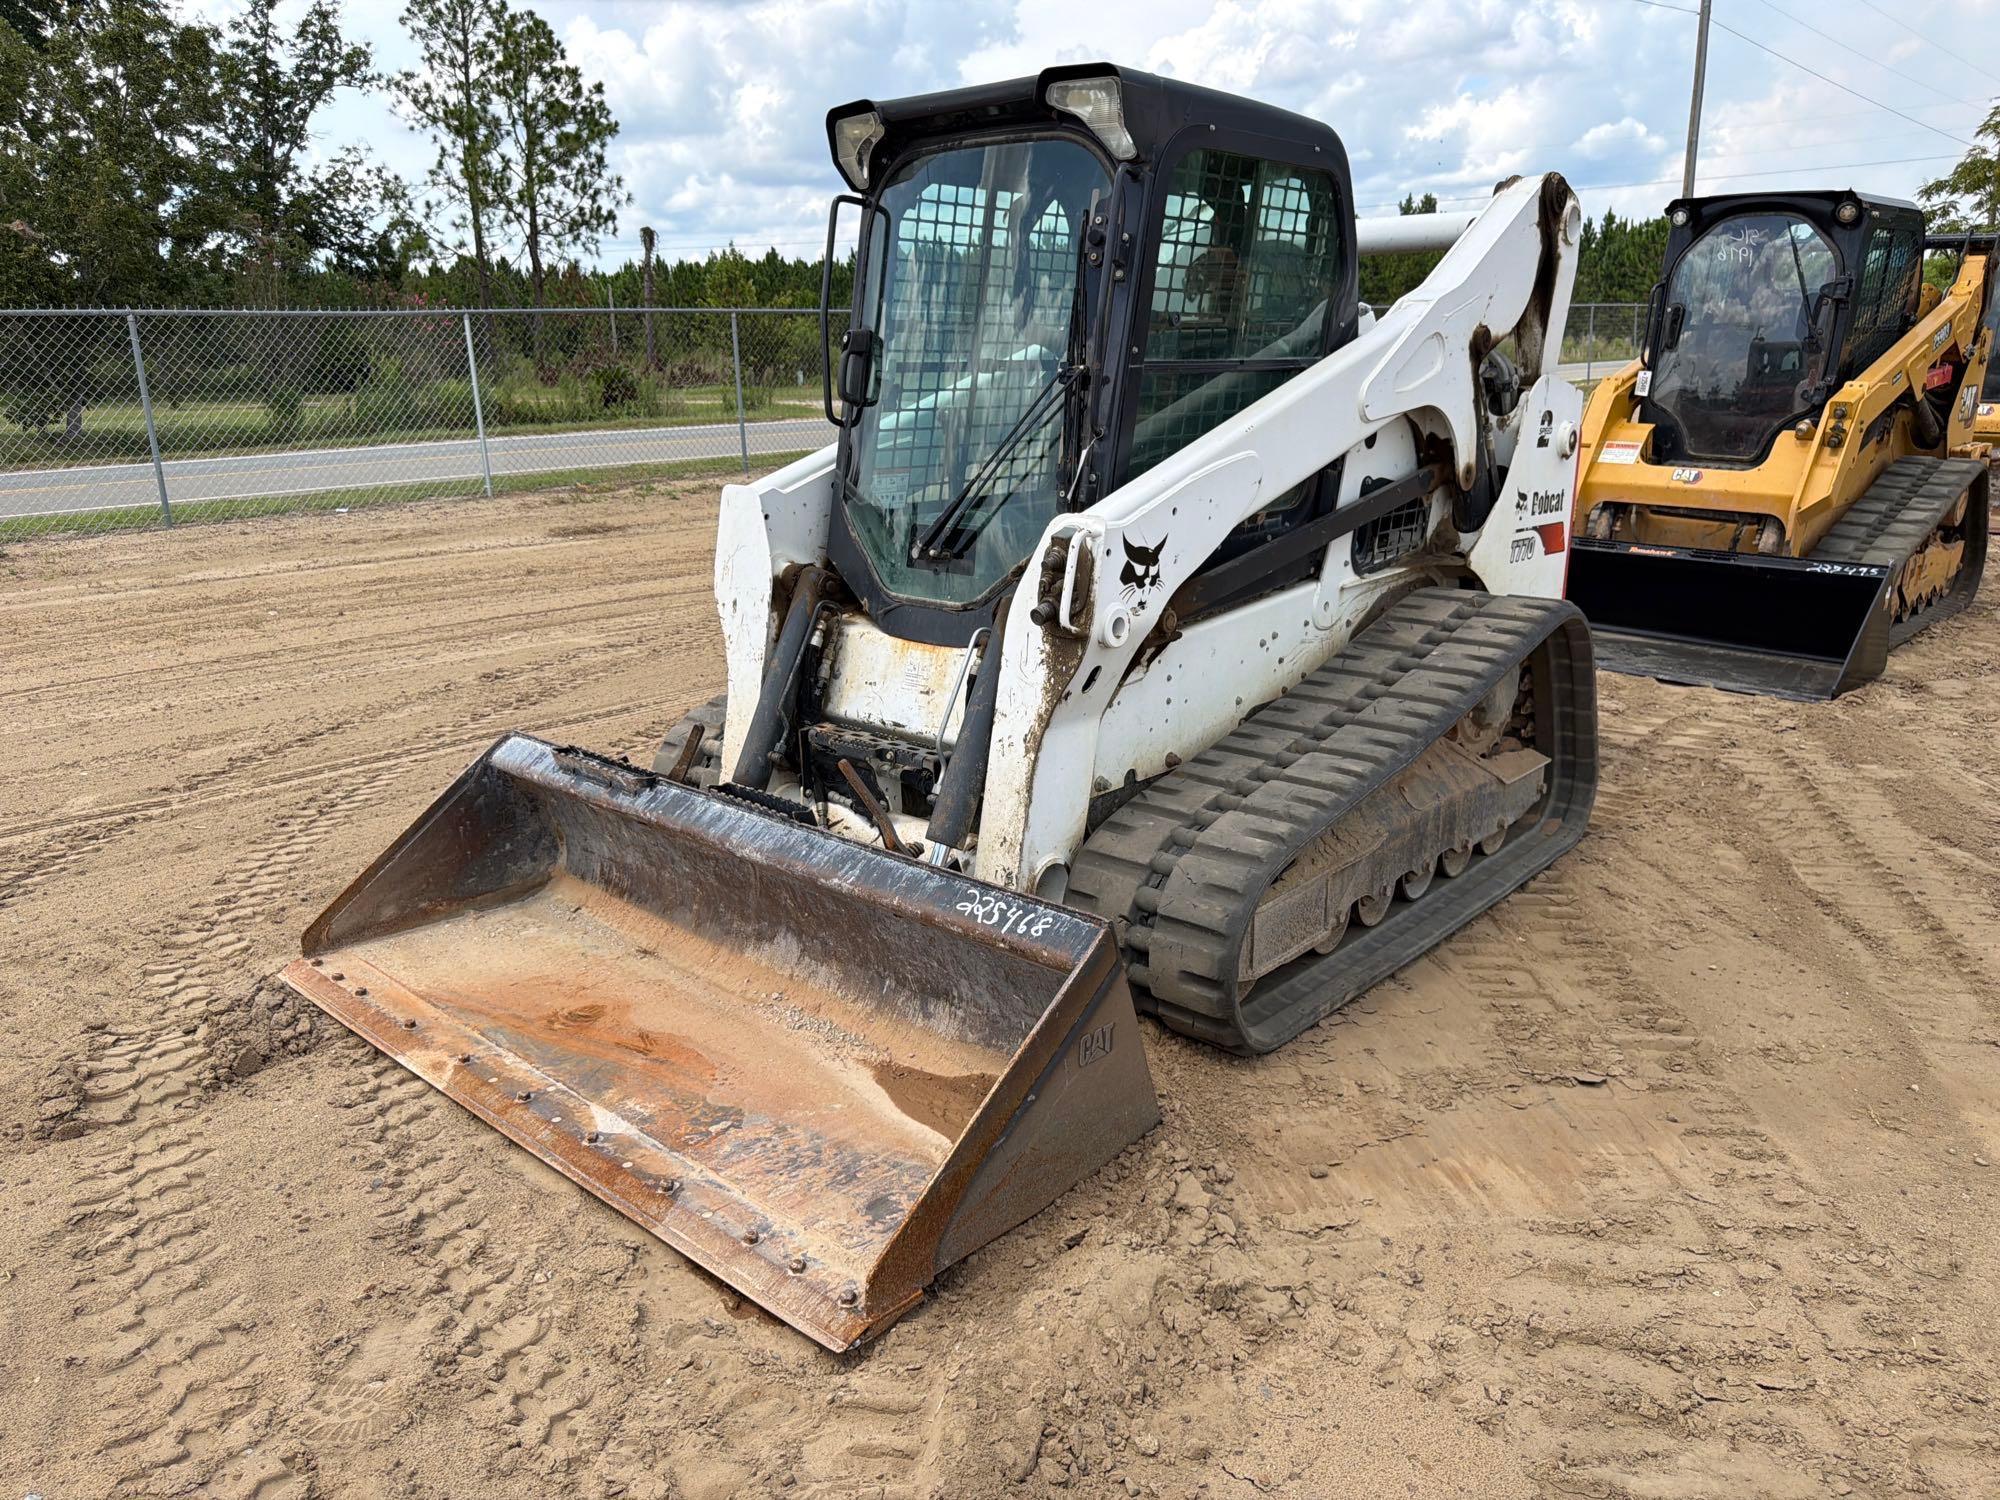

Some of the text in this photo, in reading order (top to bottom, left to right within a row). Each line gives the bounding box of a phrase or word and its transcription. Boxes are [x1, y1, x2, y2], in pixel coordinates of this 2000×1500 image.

[1672, 469, 1699, 482] CAT
[1531, 488, 1564, 516] Bobcat
[1510, 536, 1536, 564] T770
[956, 889, 1053, 937] 225468
[1078, 1021, 1115, 1068] CAT
